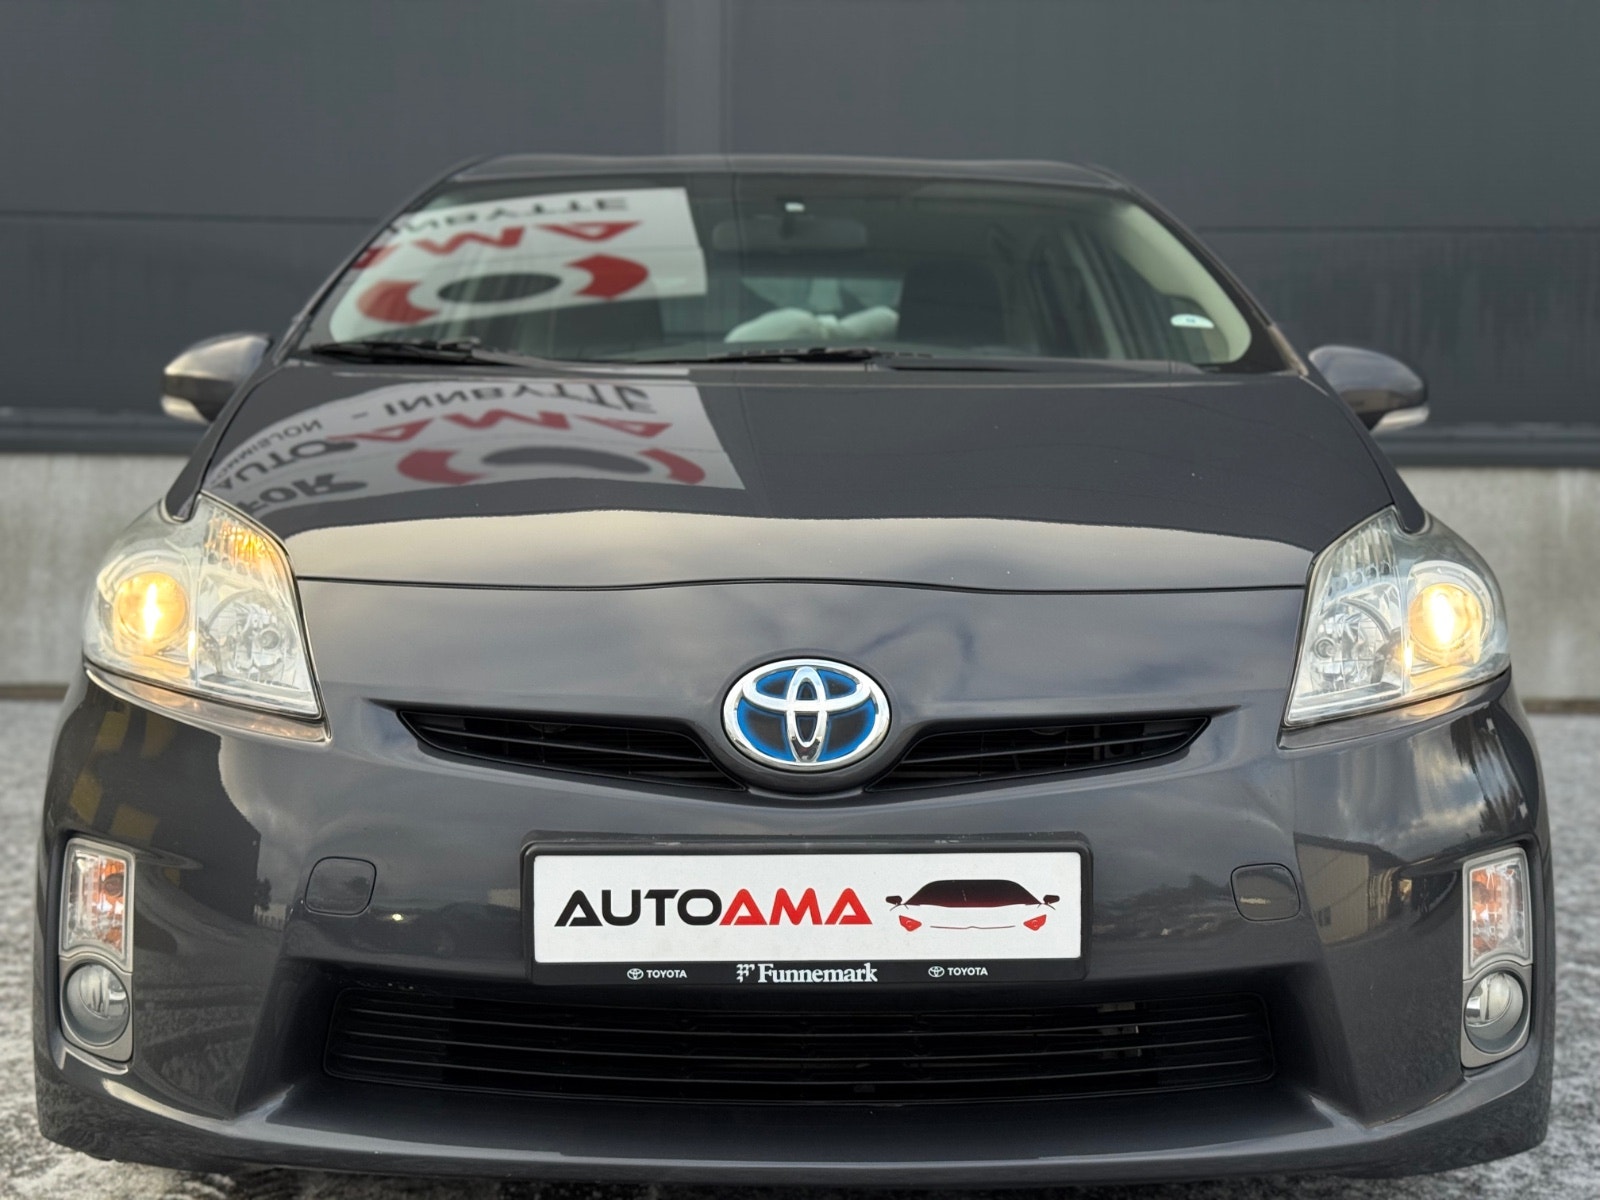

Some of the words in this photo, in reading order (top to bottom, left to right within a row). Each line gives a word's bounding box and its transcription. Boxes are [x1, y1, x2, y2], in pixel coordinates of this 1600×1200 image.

[554, 888, 873, 927] AUTOAMA
[646, 969, 687, 979] TOYOTA
[757, 962, 878, 983] Funnemark
[948, 966, 989, 977] TOYOTA
